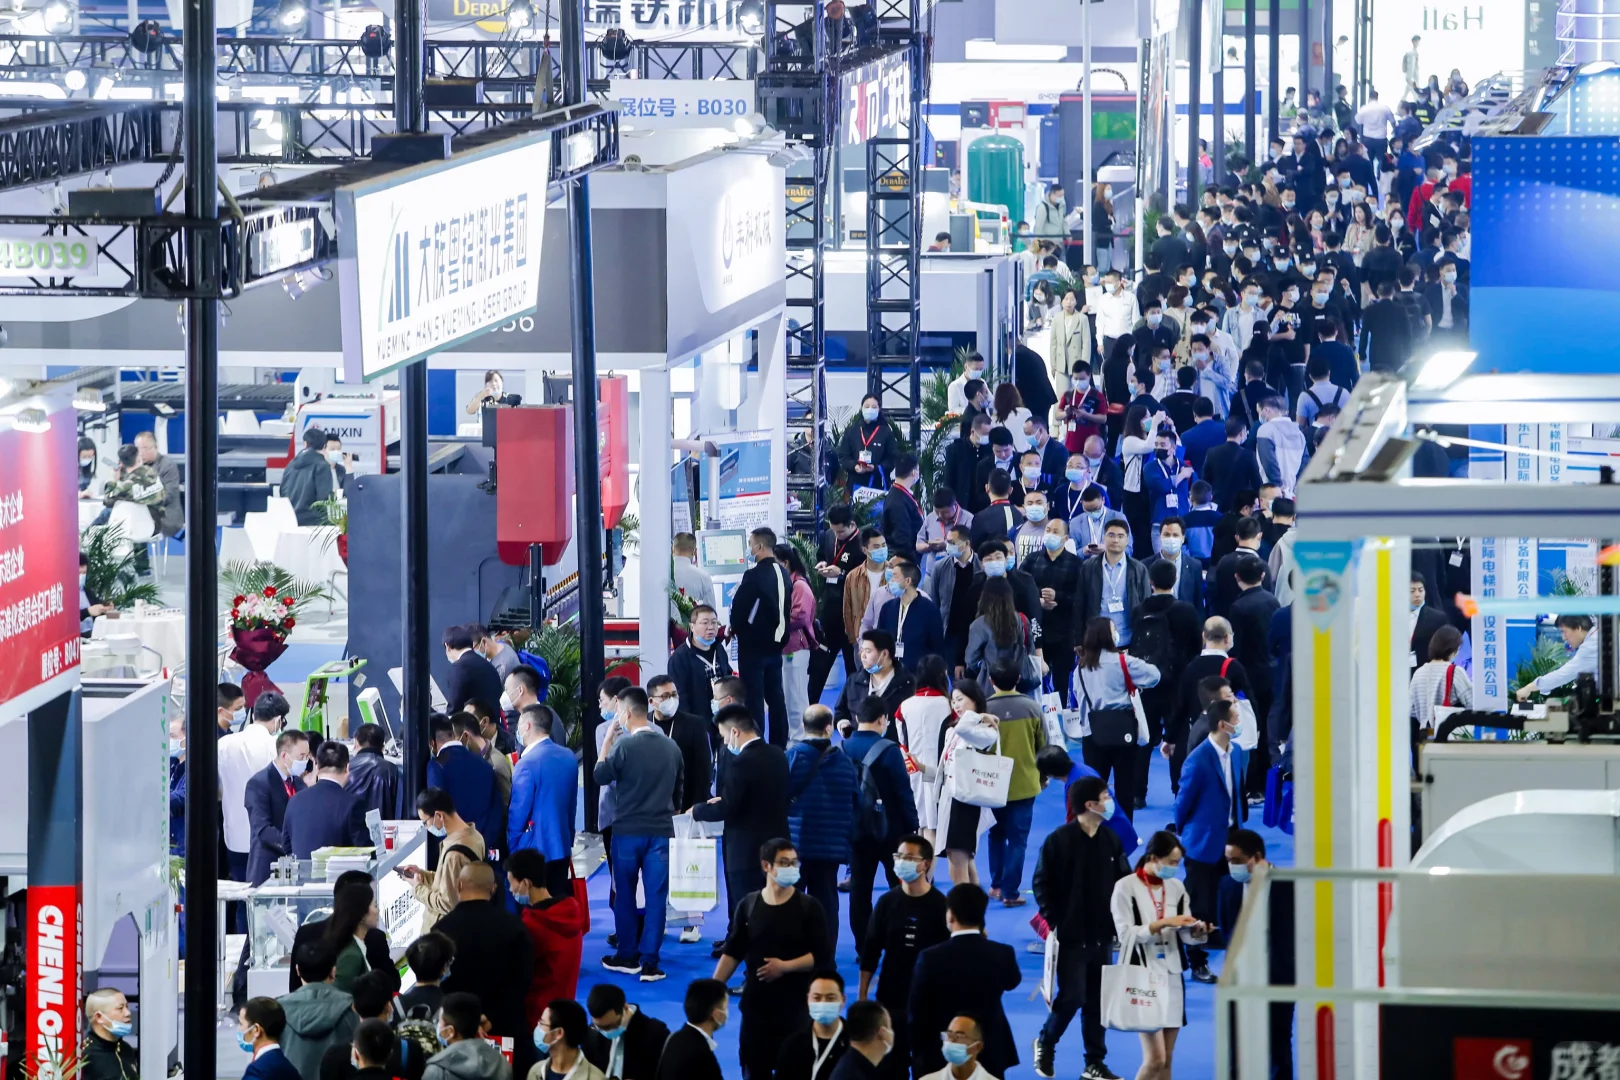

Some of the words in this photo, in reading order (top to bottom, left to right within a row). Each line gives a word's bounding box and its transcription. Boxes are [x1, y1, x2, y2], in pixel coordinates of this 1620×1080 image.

[417, 192, 528, 308] 大族粤铭激光集团
[376, 330, 411, 361] YUEMING
[442, 301, 476, 338] YUEMING
[478, 291, 502, 324] LASER
[503, 280, 528, 314] GROUP
[1481, 536, 1498, 698] 国际电梯机设备有限公司
